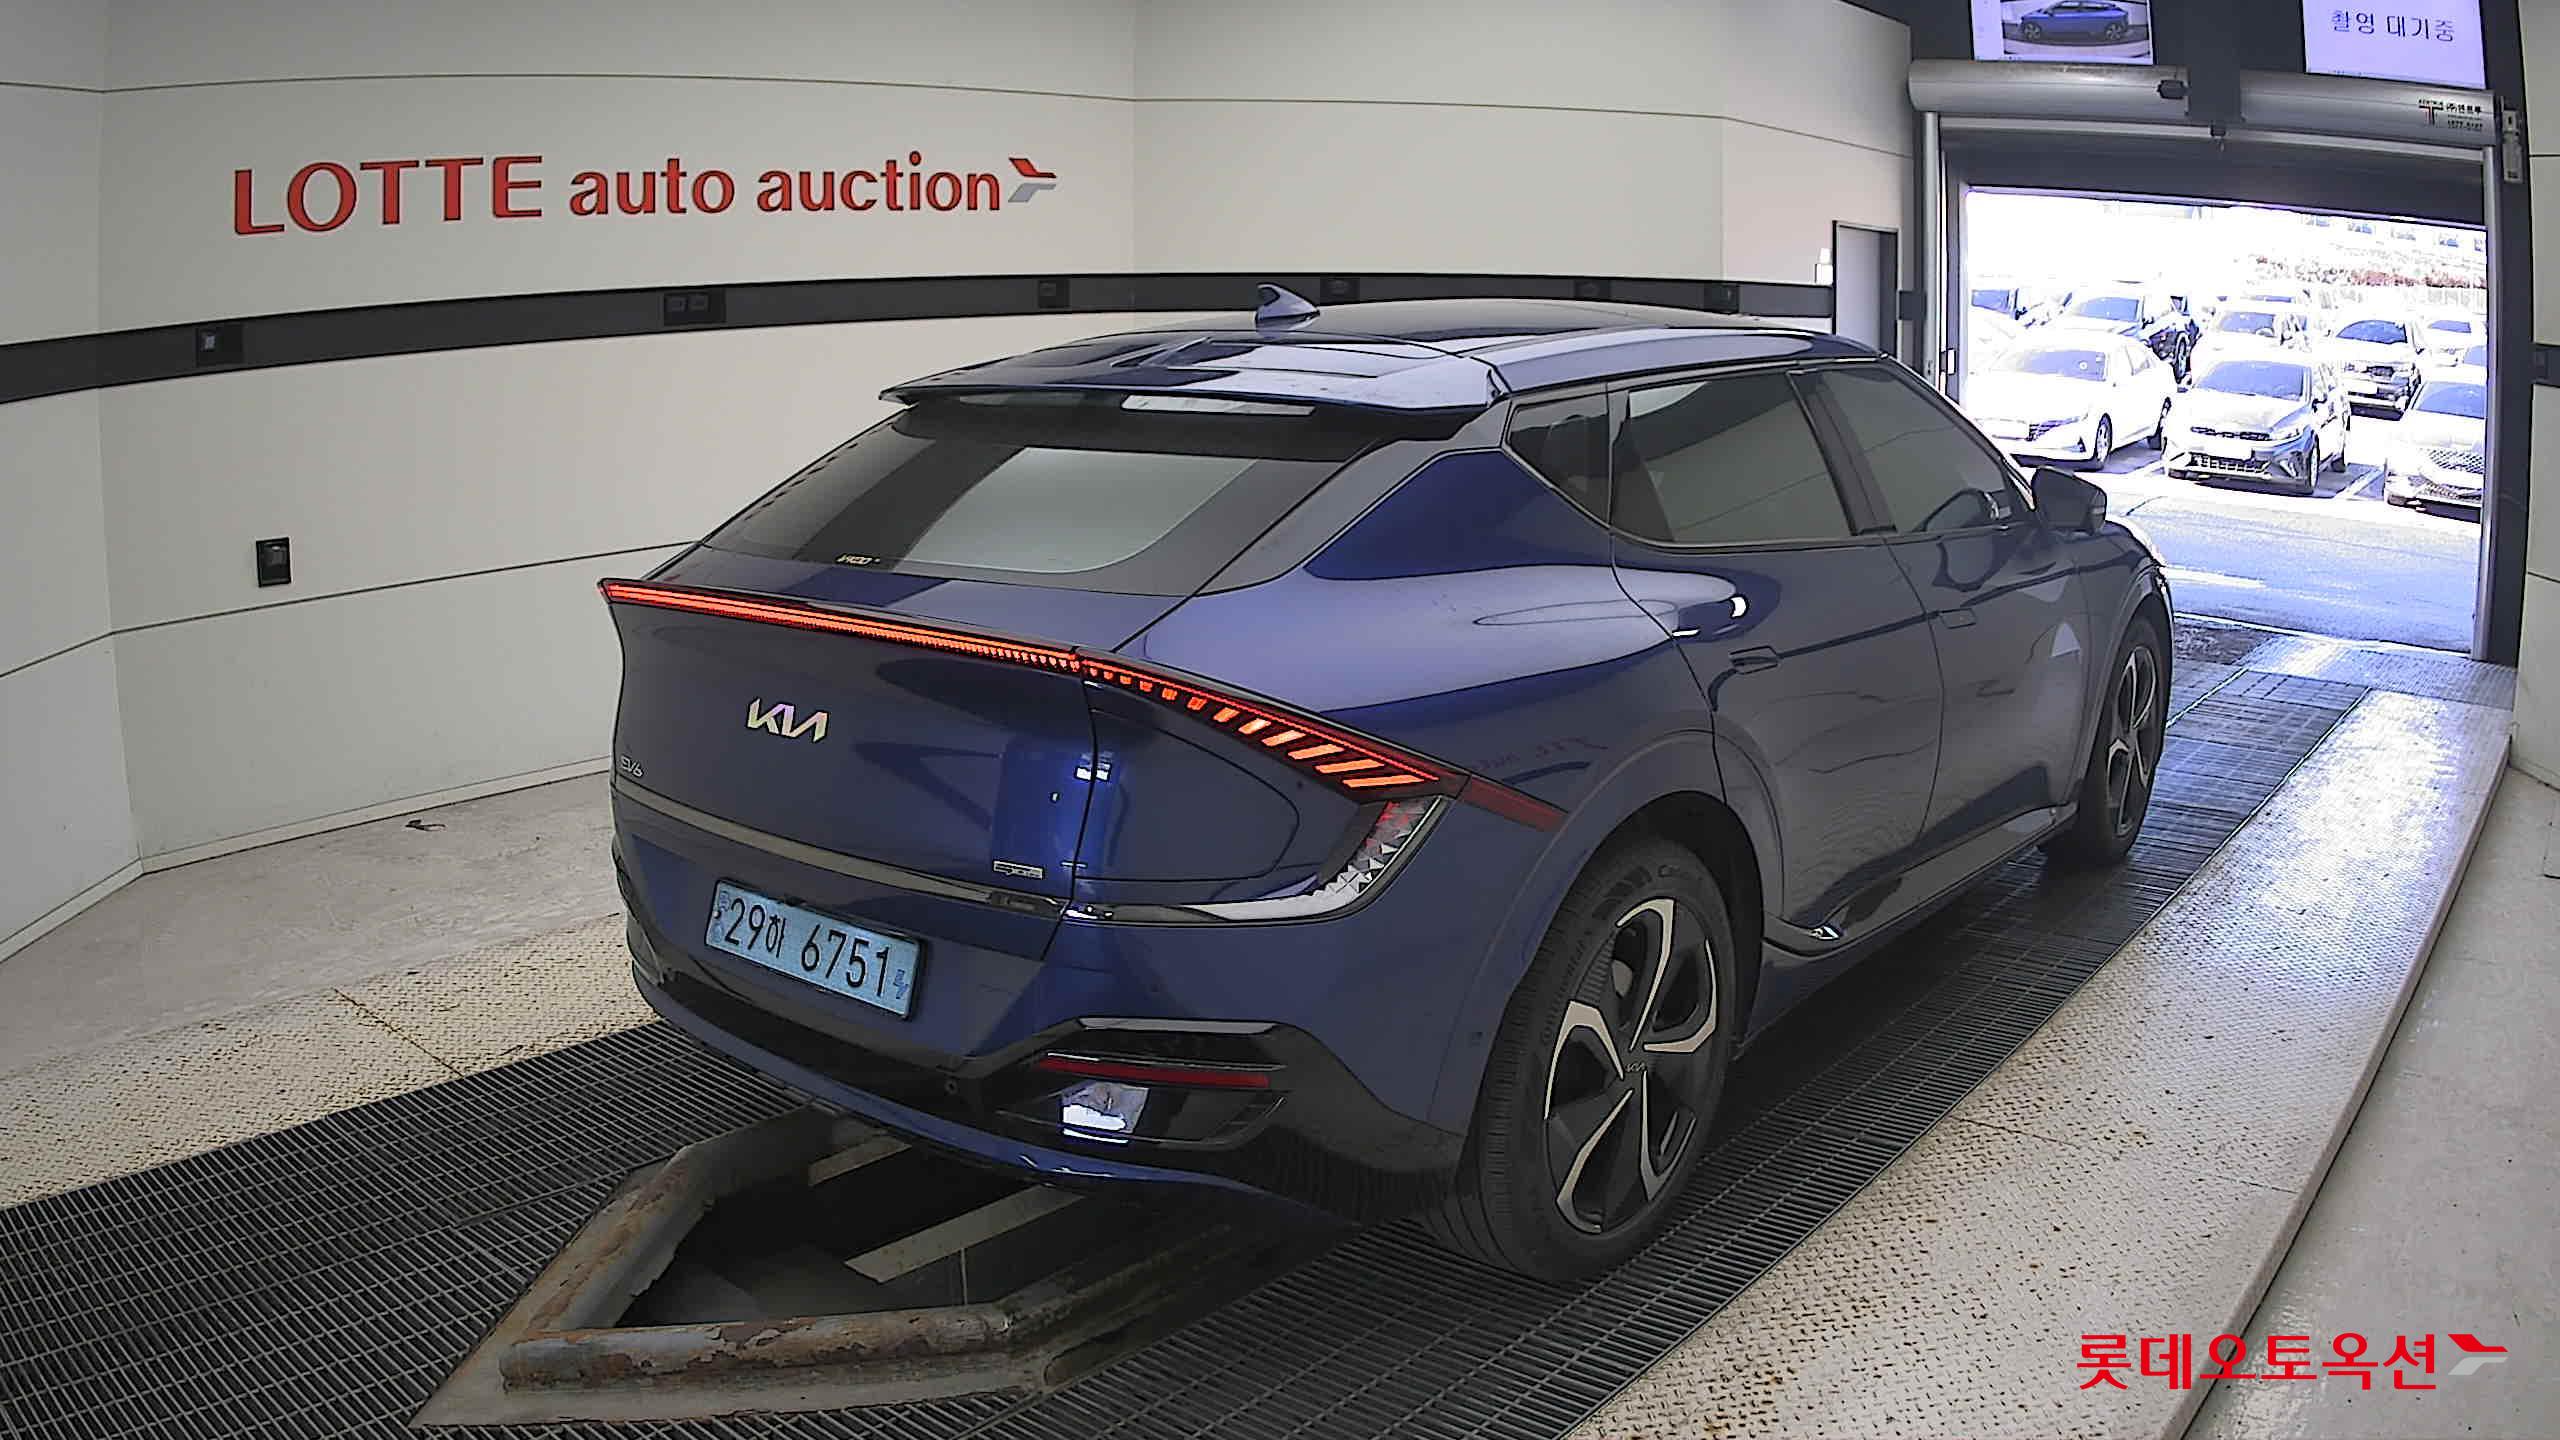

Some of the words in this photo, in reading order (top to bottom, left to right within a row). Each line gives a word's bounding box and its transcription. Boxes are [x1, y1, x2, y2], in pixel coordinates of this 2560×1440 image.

[2331, 10, 2375, 35] 촬영
[2386, 15, 2455, 42] 대기중
[234, 155, 543, 236] LOTTE
[569, 157, 735, 215] auto
[756, 151, 1002, 212] auction
[747, 698, 828, 743] KIA
[724, 897, 786, 959] 29하
[800, 923, 890, 998] 6751
